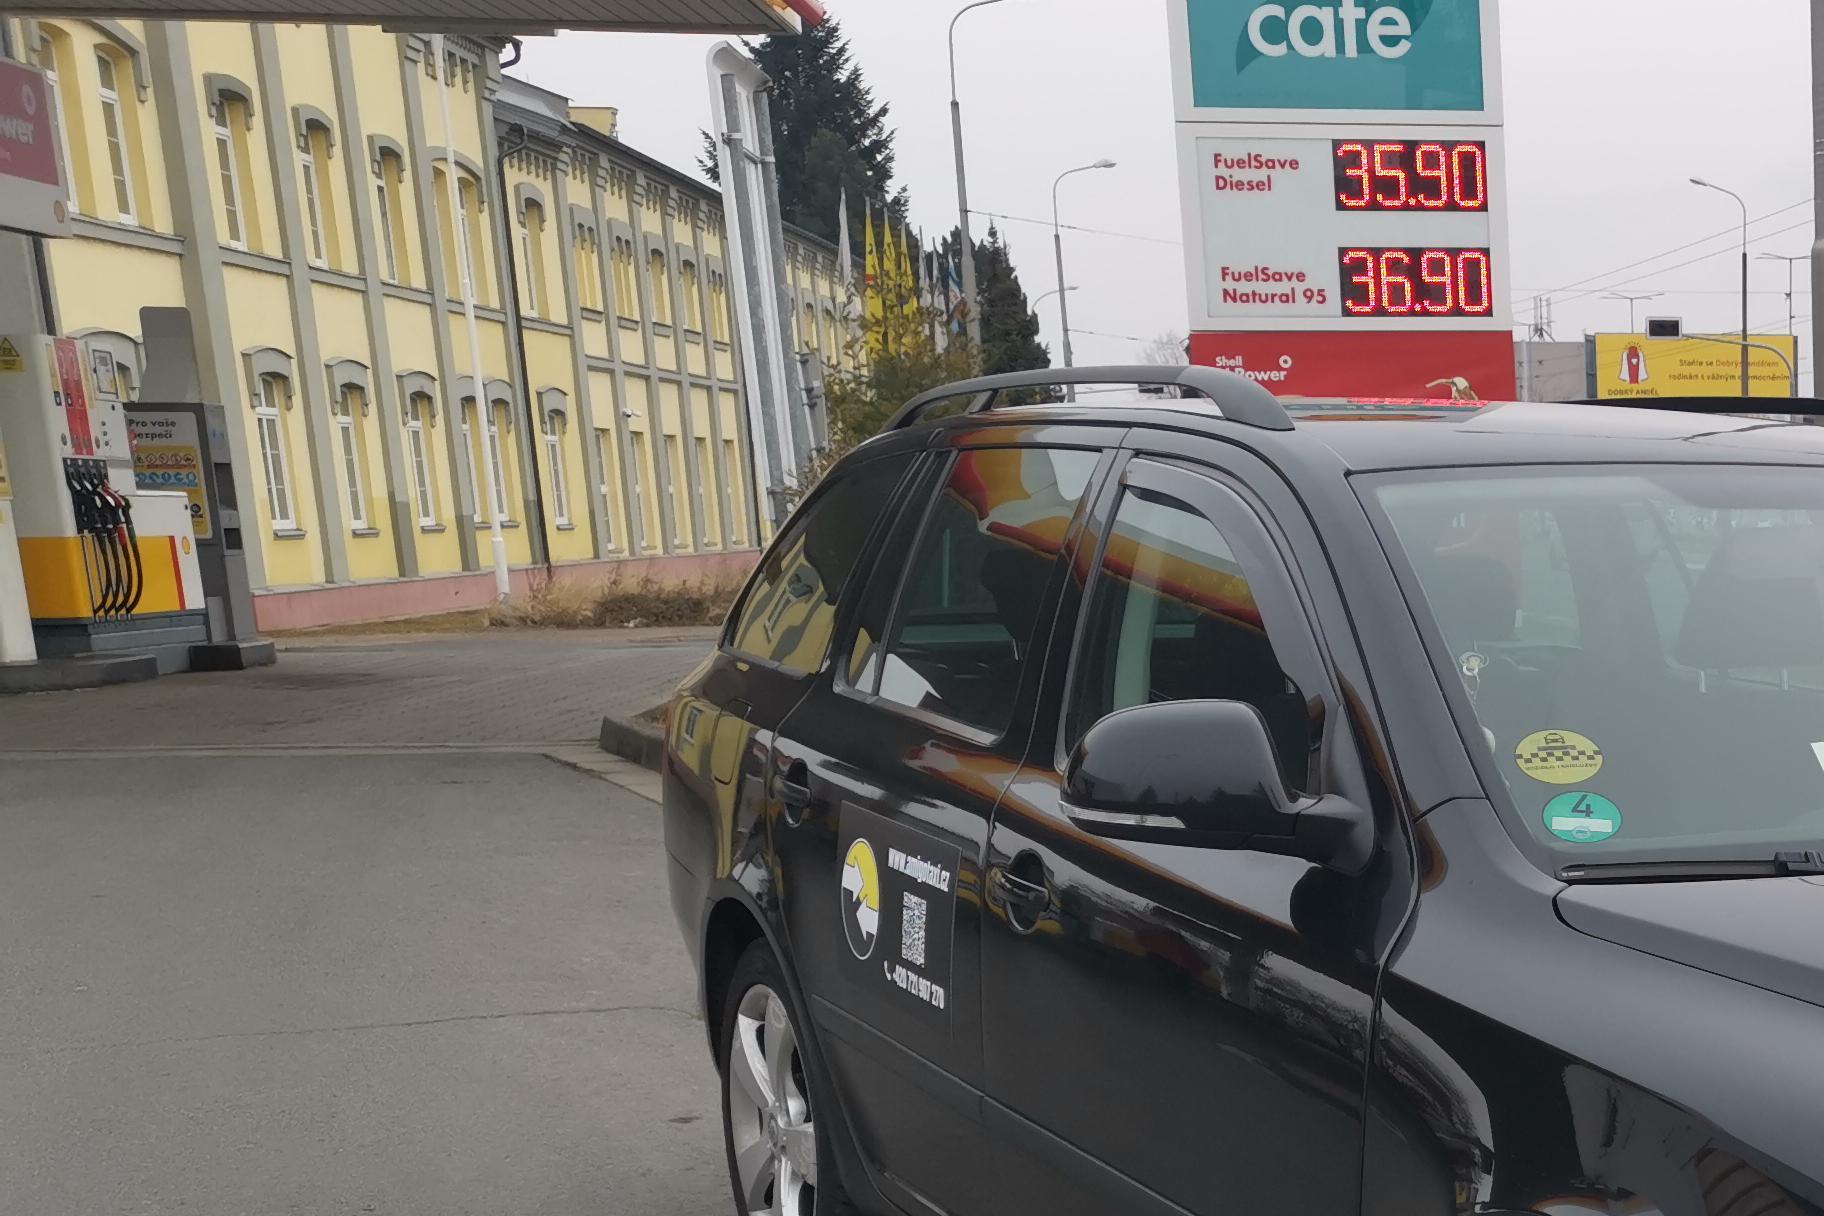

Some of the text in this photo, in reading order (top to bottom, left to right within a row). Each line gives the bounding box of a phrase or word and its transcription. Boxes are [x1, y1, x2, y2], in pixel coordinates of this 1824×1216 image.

[1213, 153, 1300, 170] FuelSave
[1215, 175, 1272, 191] Diesel
[1336, 143, 1484, 208] 35.90
[1221, 266, 1306, 283] FuelSave
[1341, 250, 1490, 313] 36.90
[1222, 288, 1327, 305] Natural 95
[1215, 355, 1243, 367] Shell
[1715, 359, 1742, 368] Dobrý
[1226, 366, 1287, 381] Power
[128, 417, 177, 428] Pro vaše
[136, 430, 173, 441] ezpečí
[1571, 794, 1594, 817] 4
